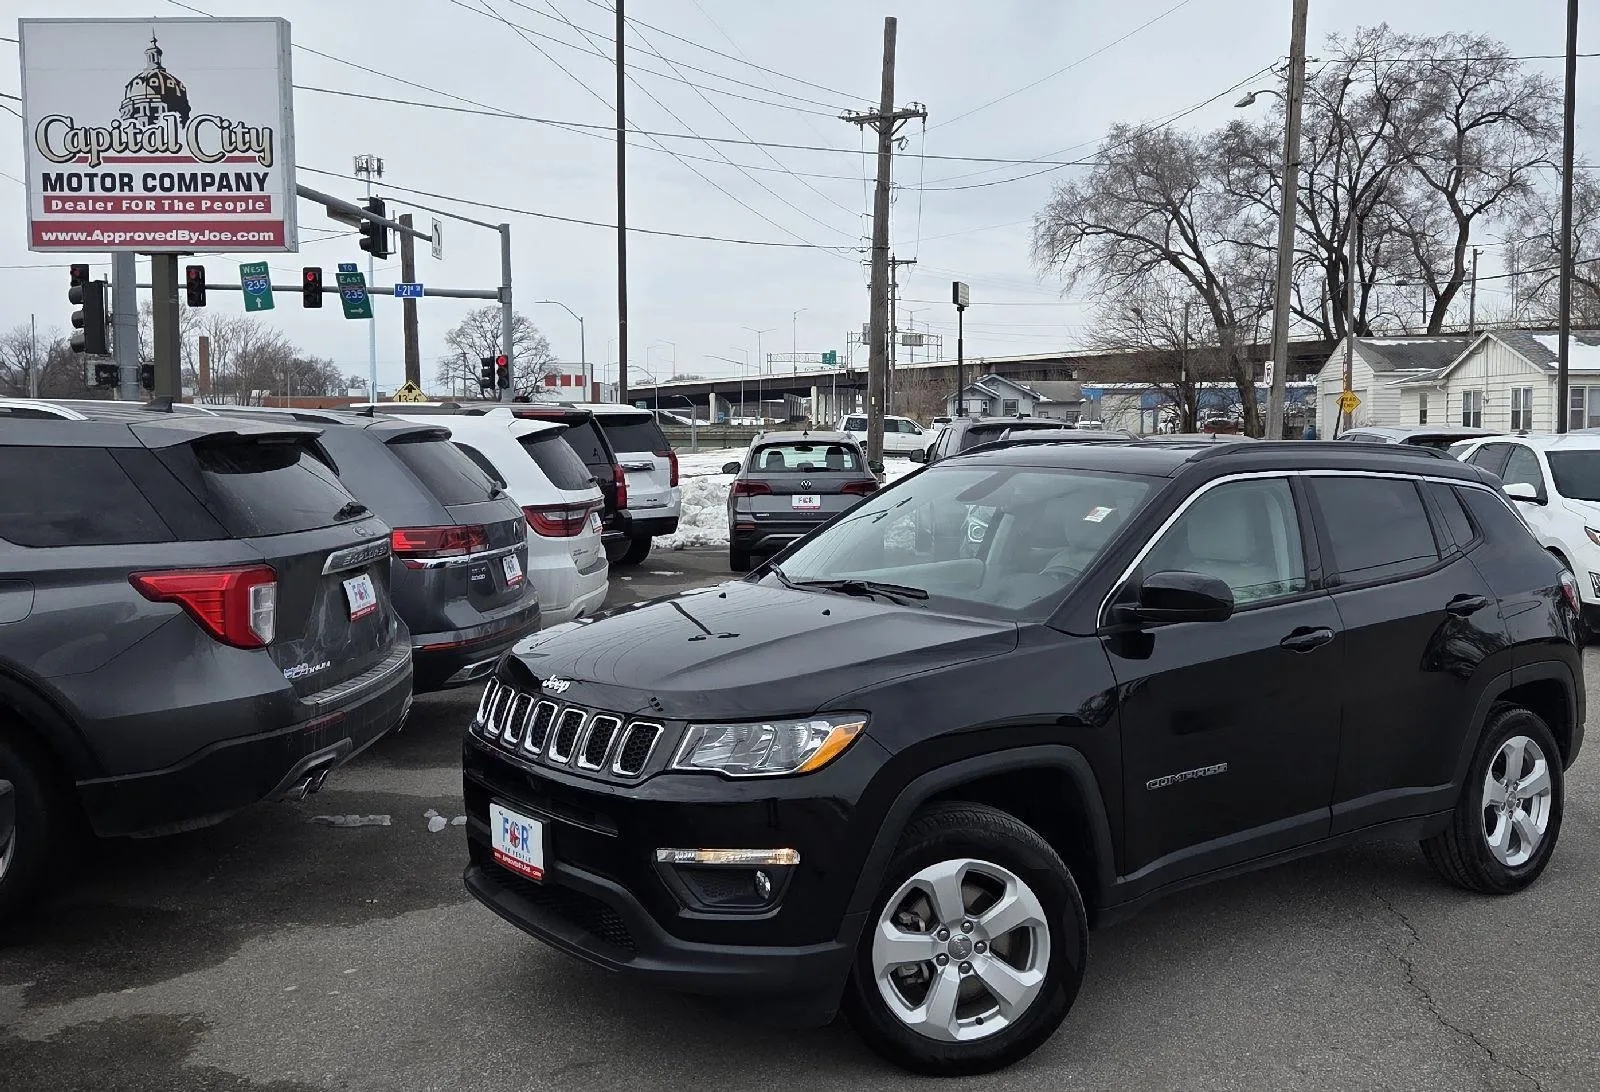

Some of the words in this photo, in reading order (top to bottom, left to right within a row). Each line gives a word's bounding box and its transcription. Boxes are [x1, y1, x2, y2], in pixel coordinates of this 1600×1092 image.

[35, 114, 182, 168] Capital
[186, 113, 274, 168] City
[42, 172, 134, 193] MOTOR
[142, 171, 270, 193] COMPANY
[51, 199, 114, 211] Dealer
[122, 199, 156, 211] FOR
[162, 199, 195, 211] The
[201, 199, 265, 213] People
[41, 229, 274, 243] www.ApprovedByJoe.com
[242, 265, 265, 273] WEST
[247, 279, 267, 290] 235
[345, 289, 364, 299] 235
[542, 674, 571, 694] Jeep
[1146, 762, 1228, 790] COMPASS
[502, 816, 531, 854] FOR
